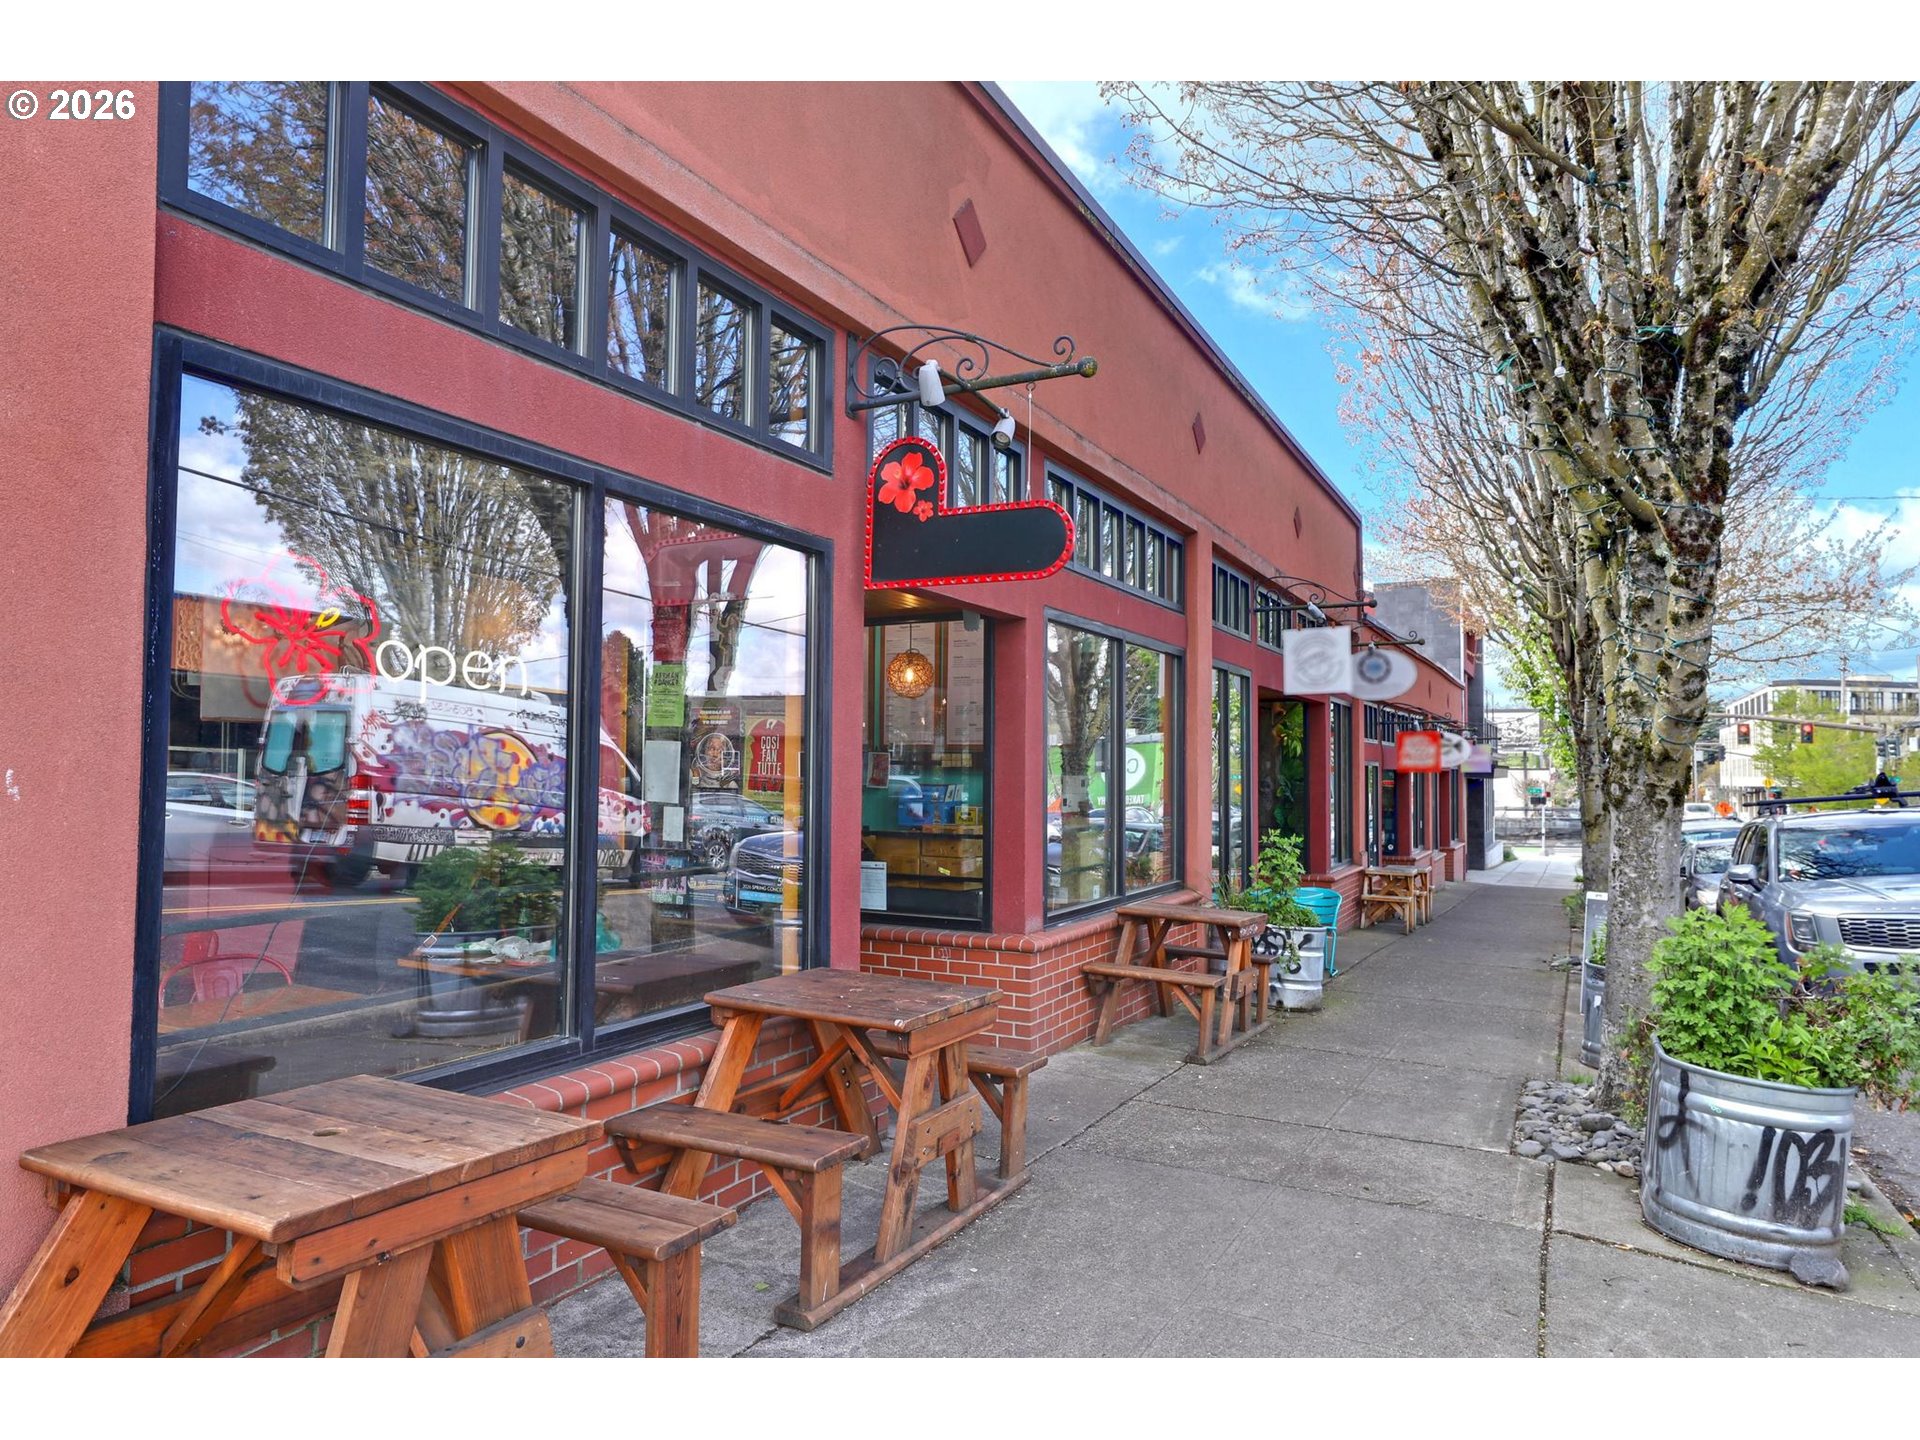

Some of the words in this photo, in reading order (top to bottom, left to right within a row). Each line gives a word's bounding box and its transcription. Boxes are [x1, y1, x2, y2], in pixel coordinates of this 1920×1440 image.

[375, 639, 528, 704] open
[761, 749, 778, 762] FAN
[757, 762, 781, 776] TUTTE
